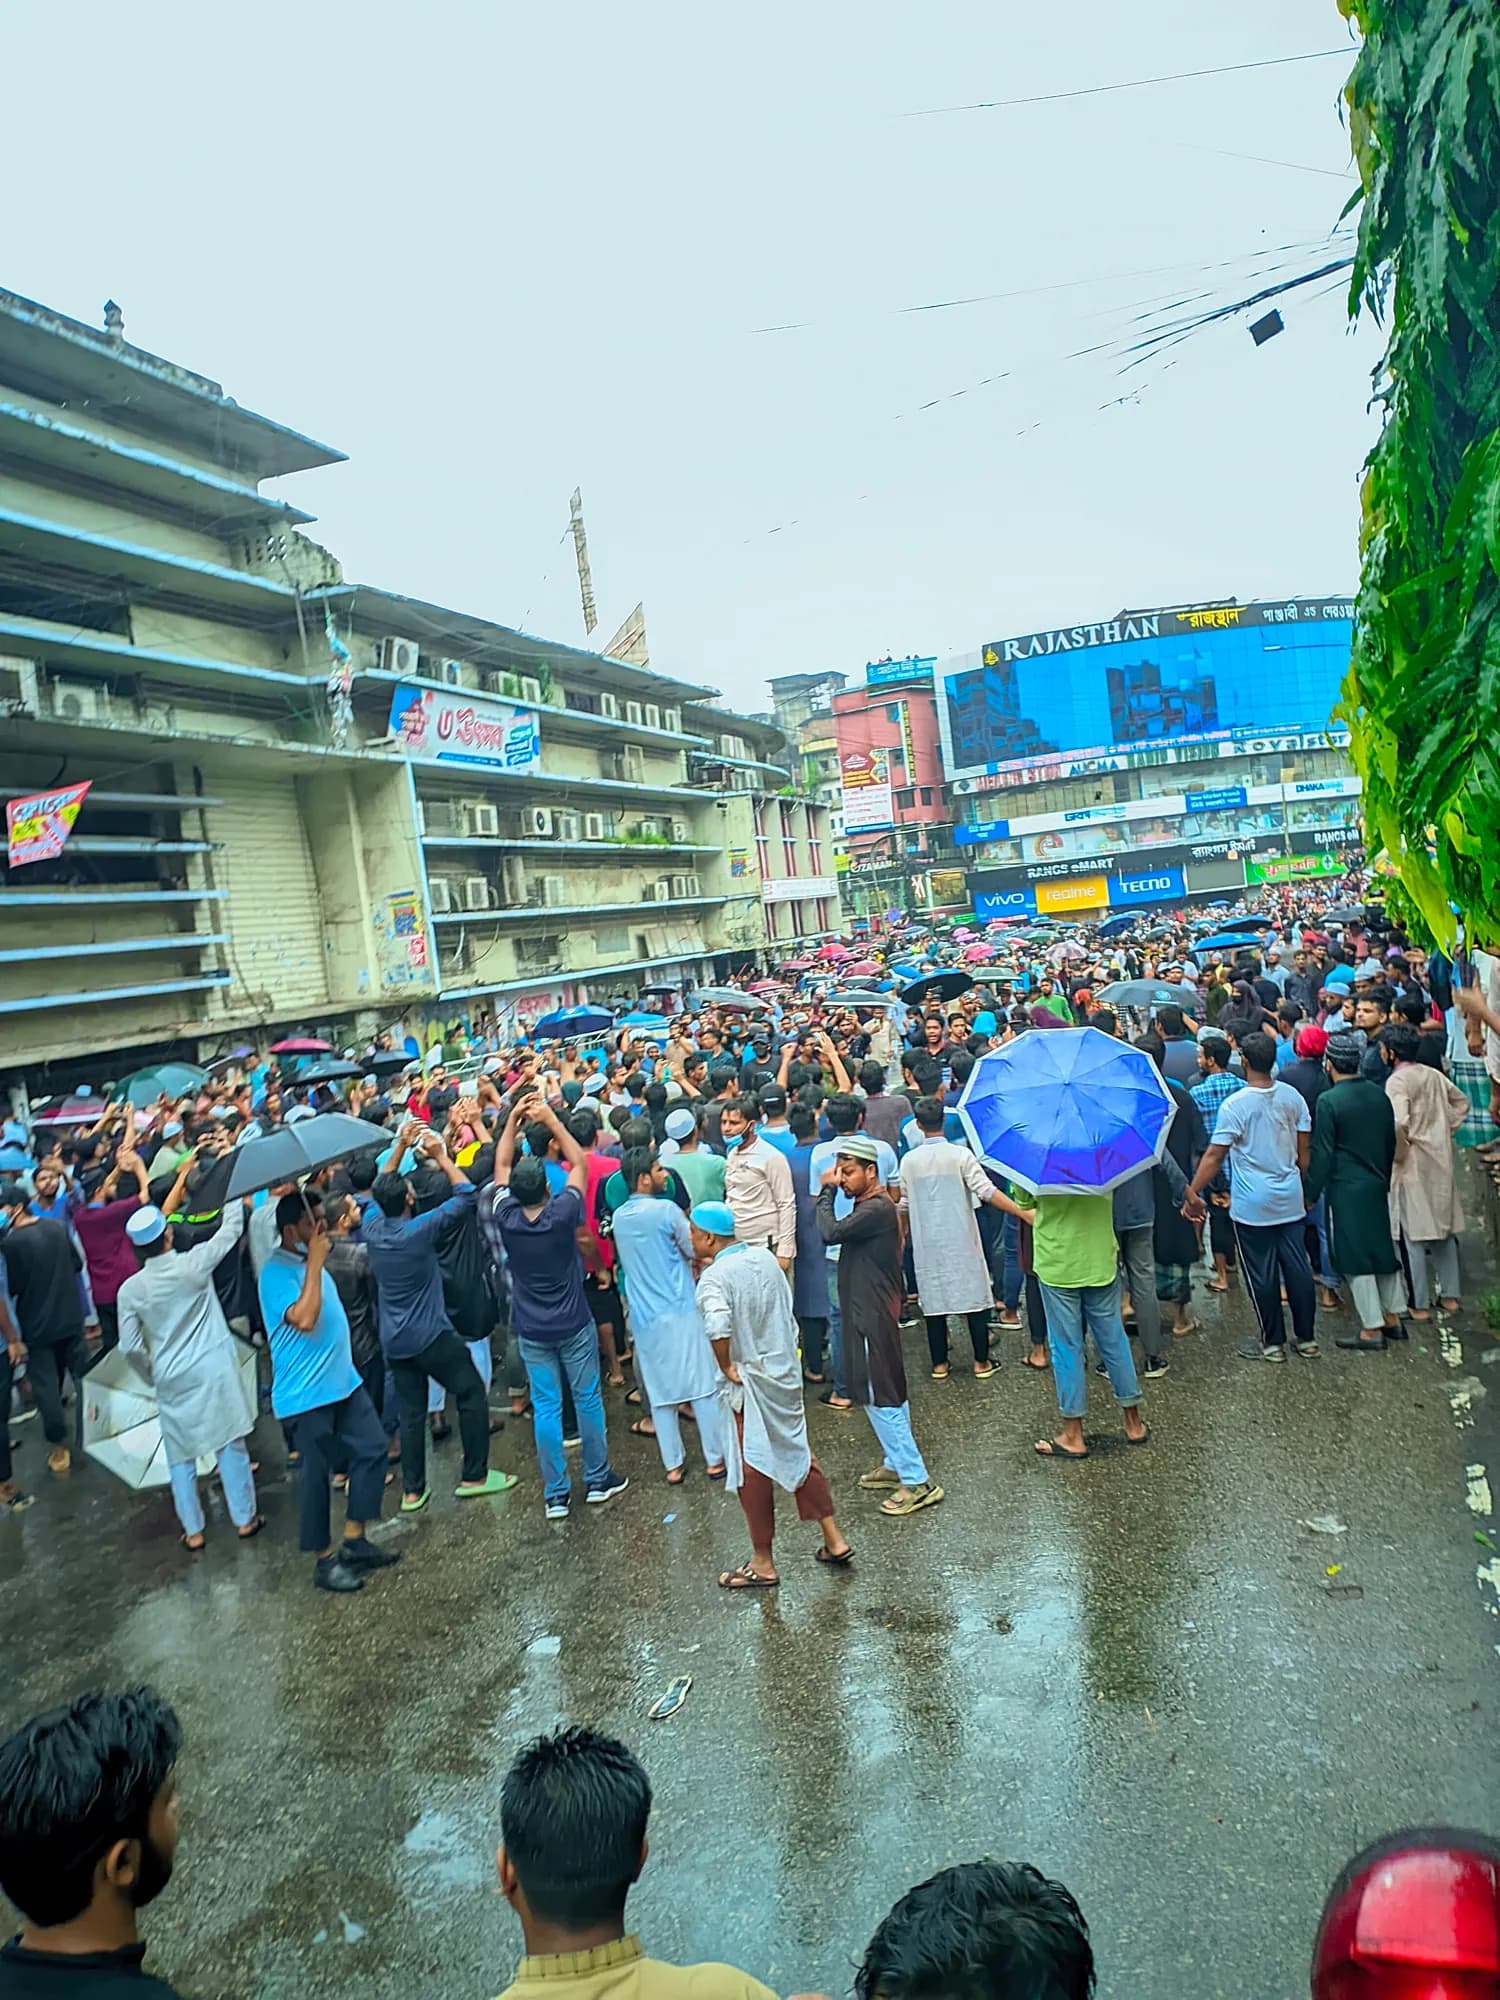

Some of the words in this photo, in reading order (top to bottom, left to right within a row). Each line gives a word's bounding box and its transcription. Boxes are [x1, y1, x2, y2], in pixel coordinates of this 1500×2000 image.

[1004, 616, 1160, 661] RAJASTHAN
[1027, 866, 1069, 879] RANGS
[1120, 877, 1171, 894] TECNO
[984, 892, 1025, 907] vivo
[1045, 886, 1096, 901] realme
